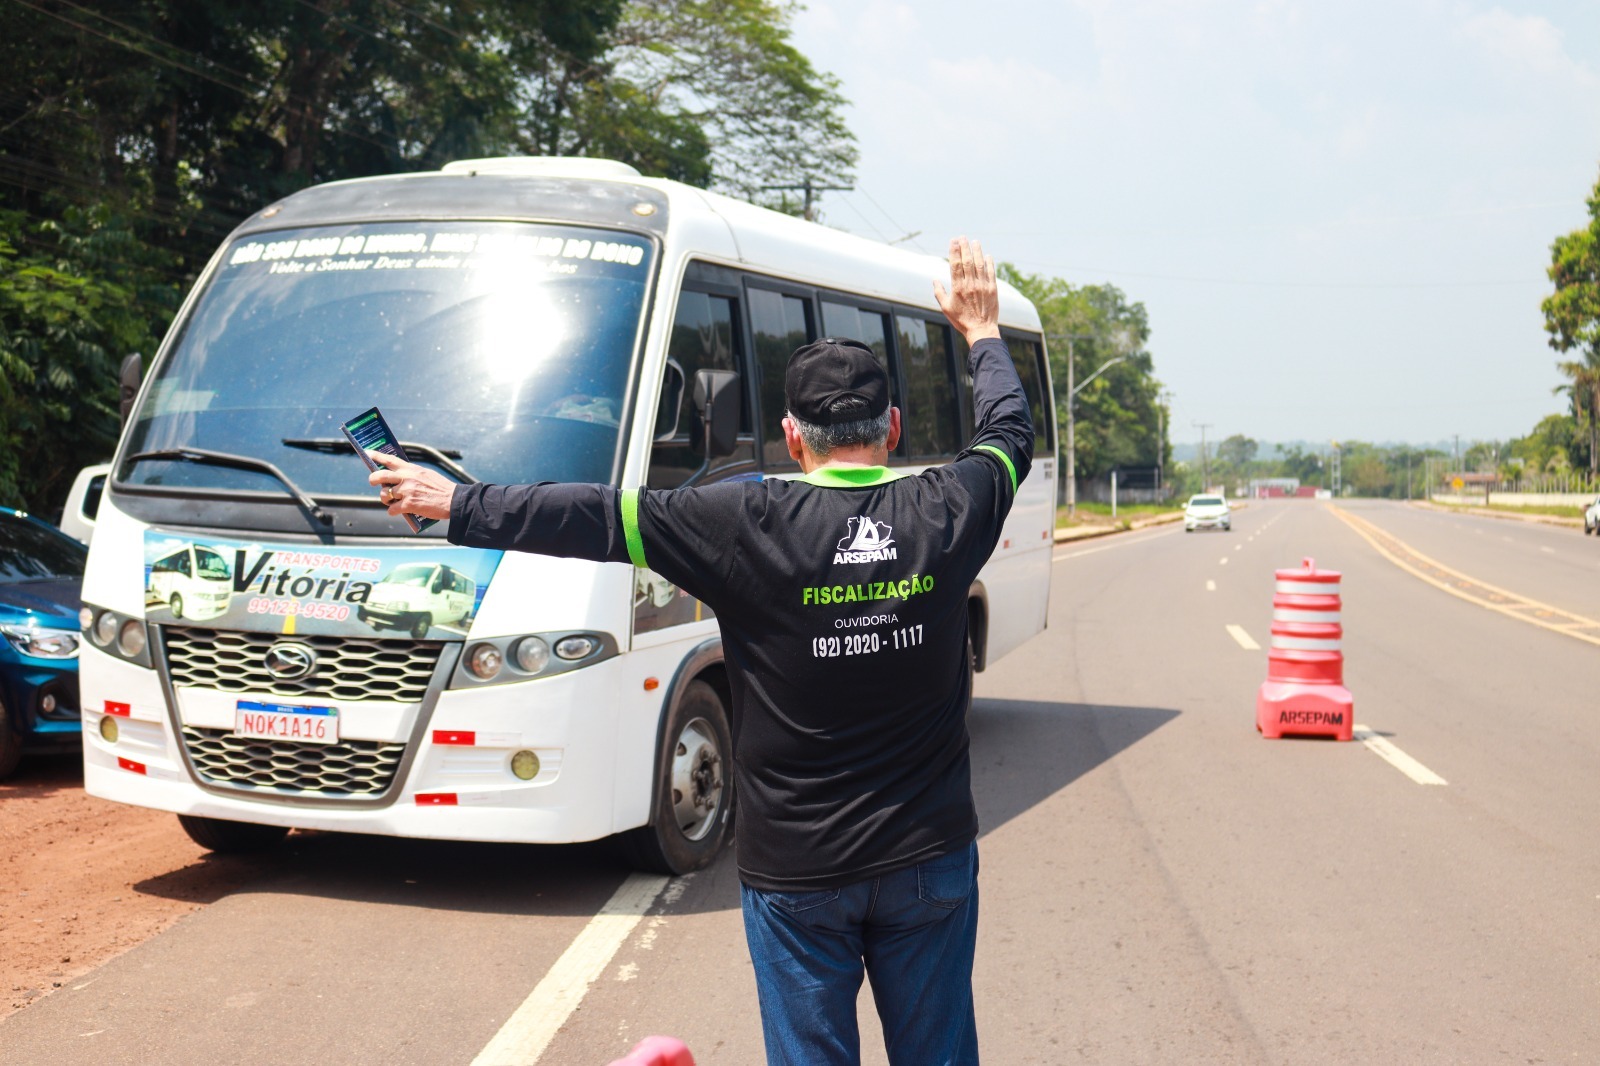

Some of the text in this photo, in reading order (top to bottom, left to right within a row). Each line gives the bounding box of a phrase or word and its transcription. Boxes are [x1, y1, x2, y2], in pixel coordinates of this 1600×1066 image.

[339, 235, 366, 254] DO
[562, 238, 592, 259] DO
[590, 241, 644, 266] DONO
[316, 256, 374, 272] Sonhar
[373, 255, 414, 270] Deus
[275, 552, 381, 573] TRANSPORTES
[832, 547, 897, 565] ARSEPAM
[232, 549, 373, 605] Vitória
[802, 573, 935, 605] FISCALIZAÇÃO
[248, 598, 350, 622] 99123-9520
[834, 613, 899, 629] OUVIDORIA
[812, 636, 841, 658] (92)
[845, 632, 880, 656] 2020
[892, 624, 923, 650] 1117
[244, 713, 326, 739] NOK1A16
[1279, 710, 1343, 726] ARSEPAM
